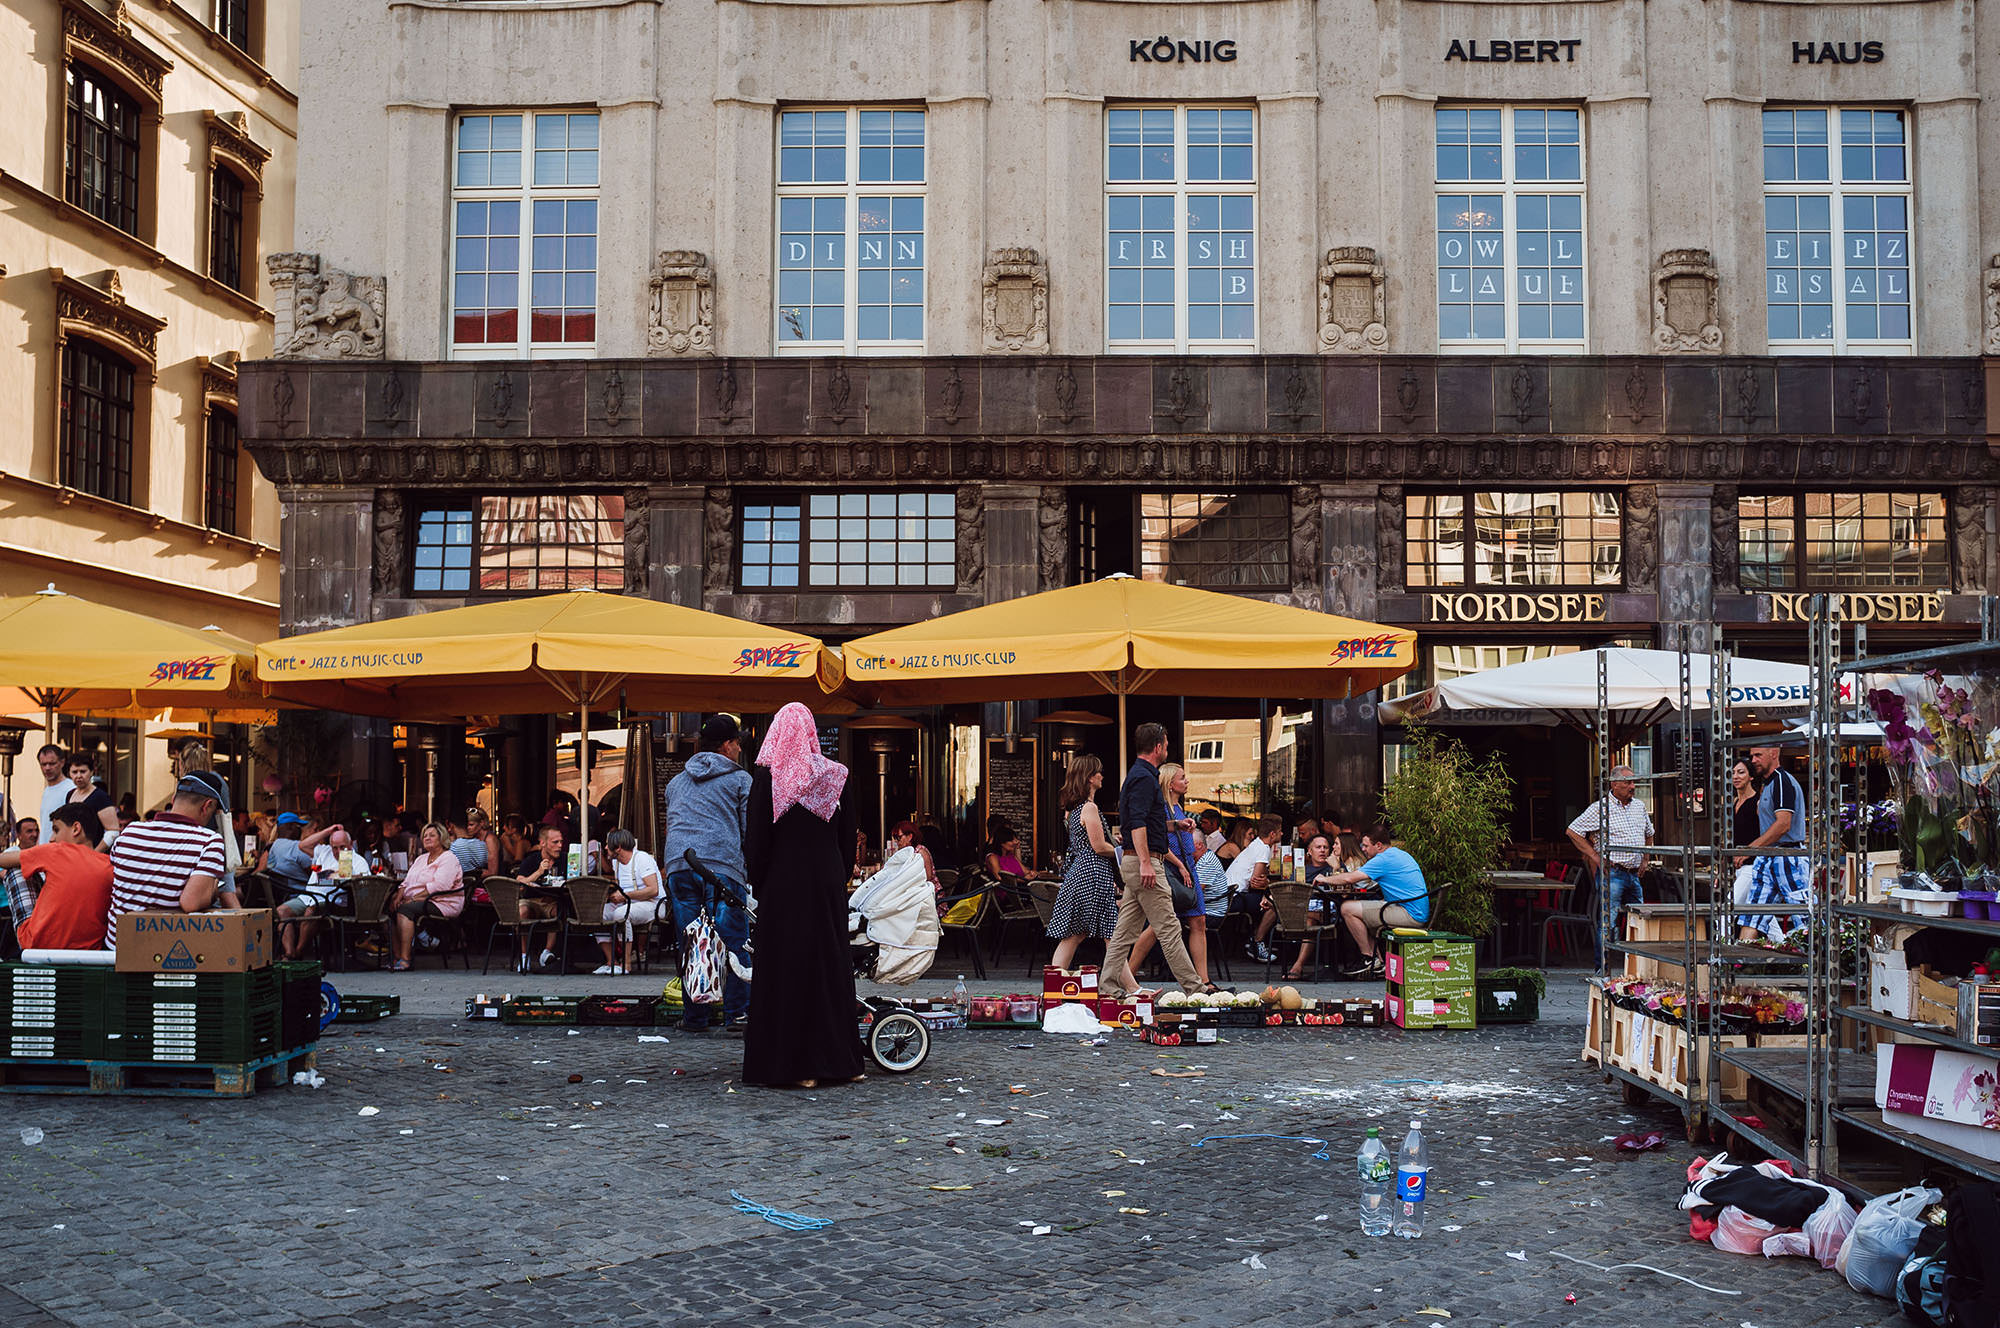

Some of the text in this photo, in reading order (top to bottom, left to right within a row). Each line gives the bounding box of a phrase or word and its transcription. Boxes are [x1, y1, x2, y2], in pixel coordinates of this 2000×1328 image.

[1129, 36, 1884, 64] KÖNIG ALBERT HAUS
[1430, 593, 1607, 622] NORDSEE
[732, 644, 806, 671] SPIZZ
[900, 655, 928, 669] JAZZ
[931, 655, 940, 667] &
[1330, 634, 1404, 663] SPIZZ
[148, 657, 221, 684] SPIZZ
[309, 656, 337, 669] JAZZ
[340, 656, 349, 668] &
[135, 918, 225, 932] BANANAS
